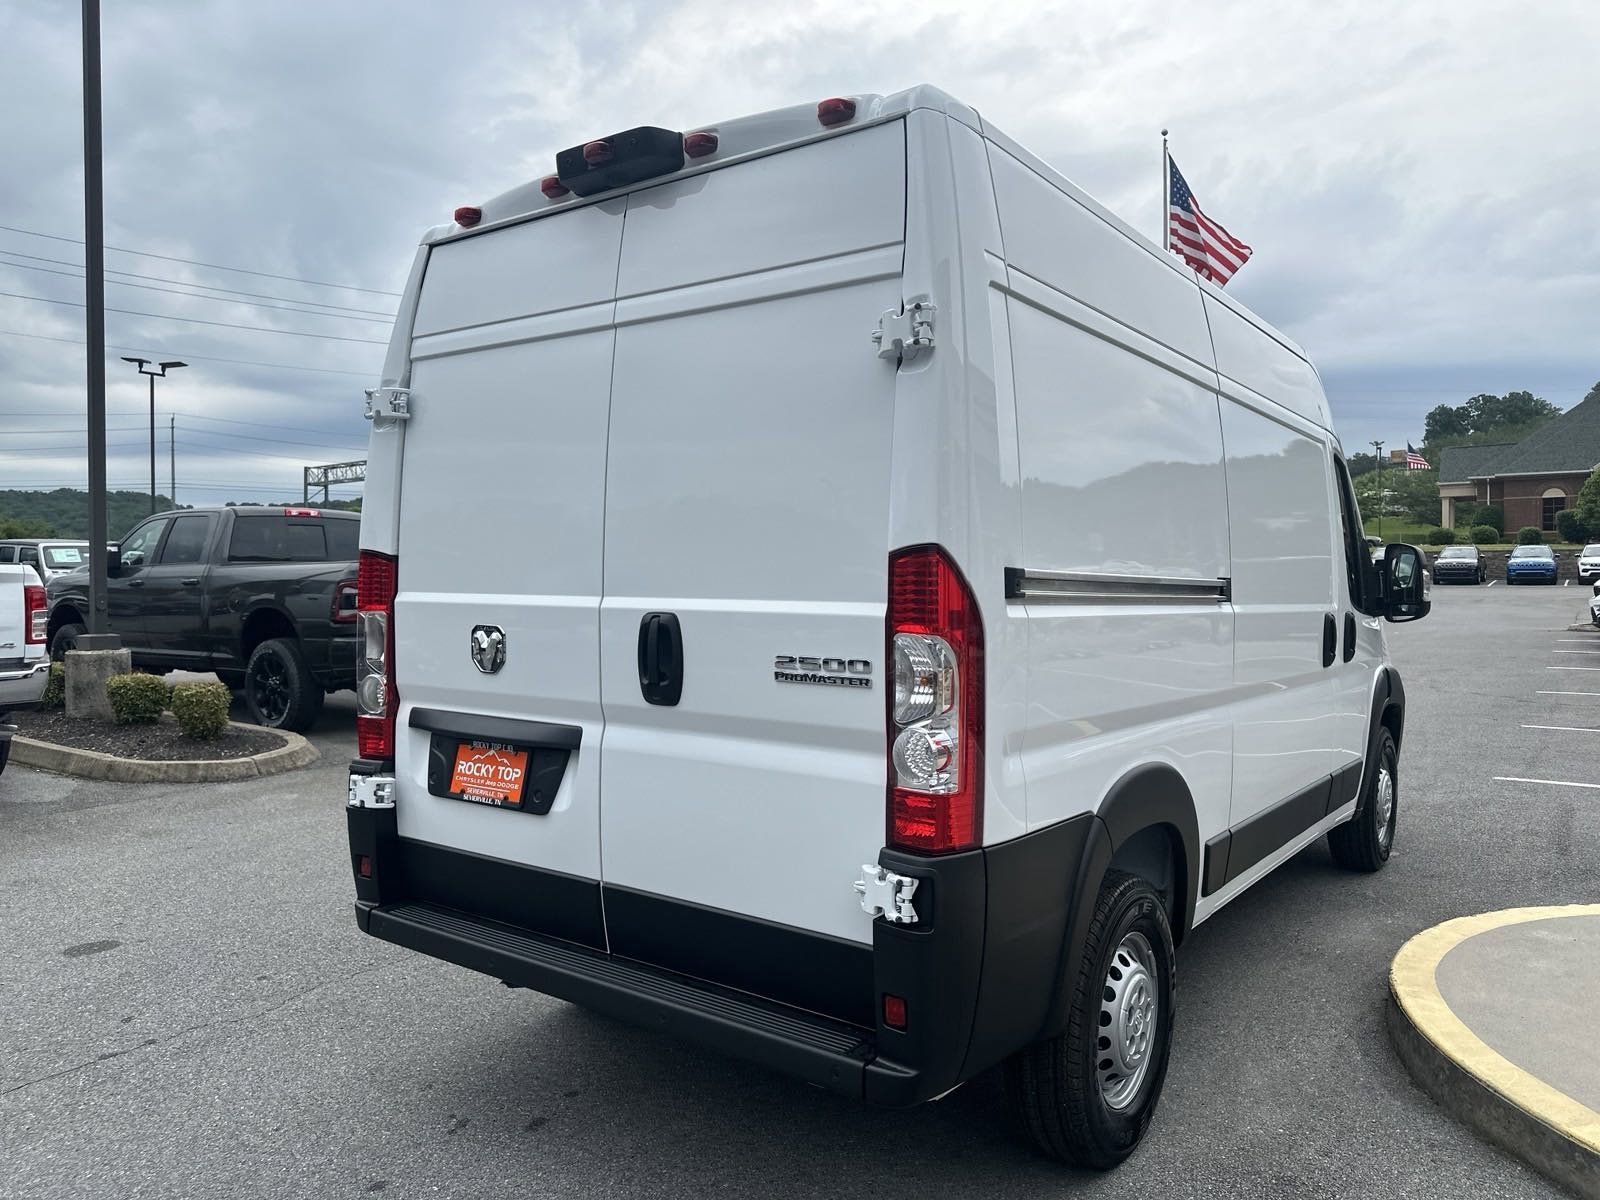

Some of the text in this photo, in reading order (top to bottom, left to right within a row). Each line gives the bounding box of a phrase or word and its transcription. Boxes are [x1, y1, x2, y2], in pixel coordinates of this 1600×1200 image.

[774, 656, 872, 675] 2500
[472, 740, 490, 750] ROCKY
[491, 743, 502, 751] TOP
[457, 760, 522, 781] ROCKY TOP
[455, 775, 519, 790] CHRYSLER Jeep DODGE
[494, 798, 502, 806] TN
